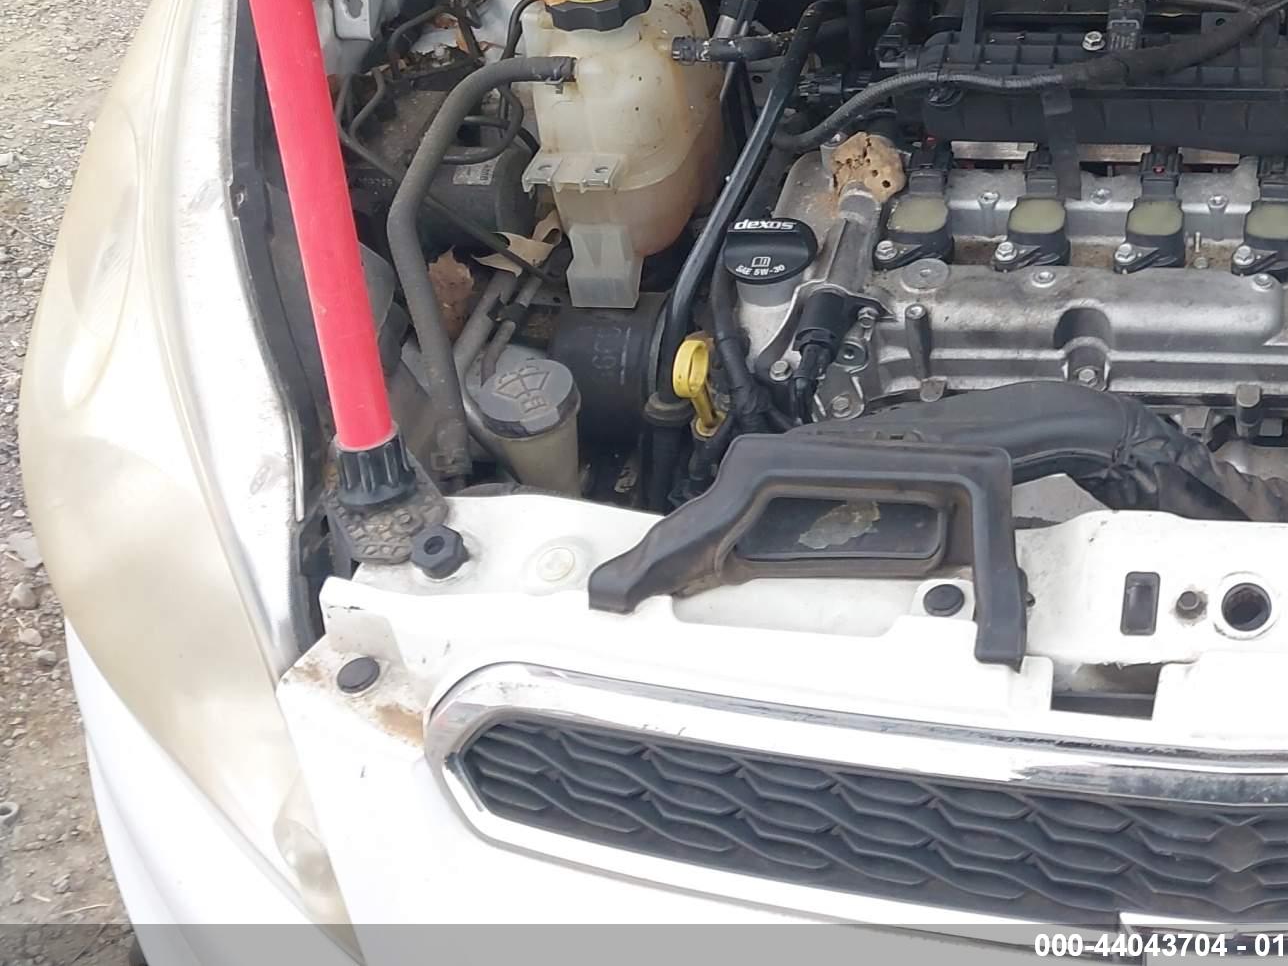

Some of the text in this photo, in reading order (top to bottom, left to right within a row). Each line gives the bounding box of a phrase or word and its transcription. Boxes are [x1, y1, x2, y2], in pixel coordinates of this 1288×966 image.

[733, 218, 797, 230] dexos
[735, 264, 786, 276] SAE 5W-30
